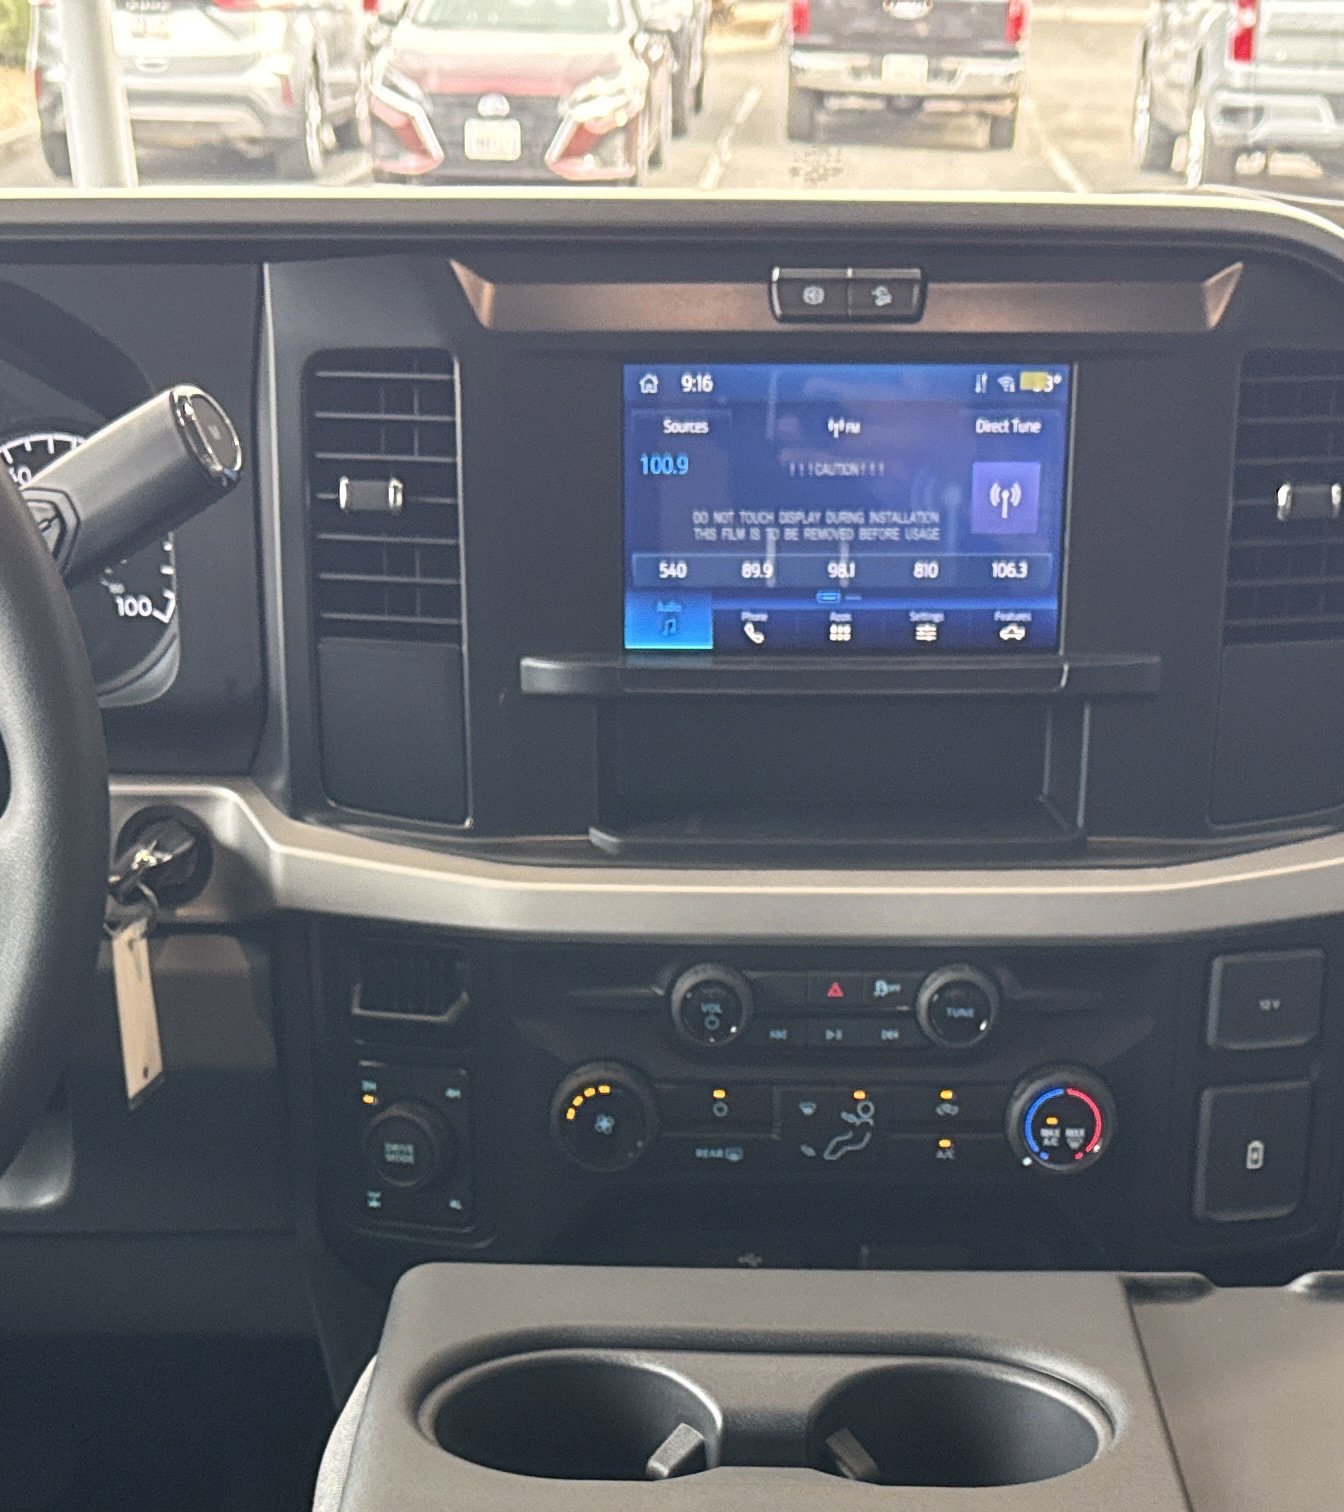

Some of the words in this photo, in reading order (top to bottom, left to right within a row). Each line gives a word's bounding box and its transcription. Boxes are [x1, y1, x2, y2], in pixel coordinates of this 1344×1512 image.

[680, 374, 714, 393] 9:16
[662, 417, 710, 434] Sources
[975, 417, 1009, 434] Direct
[1010, 417, 1042, 434] Tune
[639, 453, 689, 475] 100.9
[738, 511, 775, 525] TOUCH
[778, 511, 822, 525] DISPLAY
[825, 511, 865, 525] DURING
[869, 511, 940, 525] INSTALLATION
[693, 527, 717, 541] THIS
[784, 527, 799, 541] BE
[803, 527, 855, 541] REMOVED
[859, 527, 900, 541] BEFORE
[904, 527, 940, 541] USAGE
[659, 560, 687, 579] 540
[741, 560, 774, 579] 89.9
[827, 560, 856, 579] 98.1
[913, 560, 939, 579] 810
[991, 560, 1028, 579] 106.3
[115, 594, 153, 617] 100
